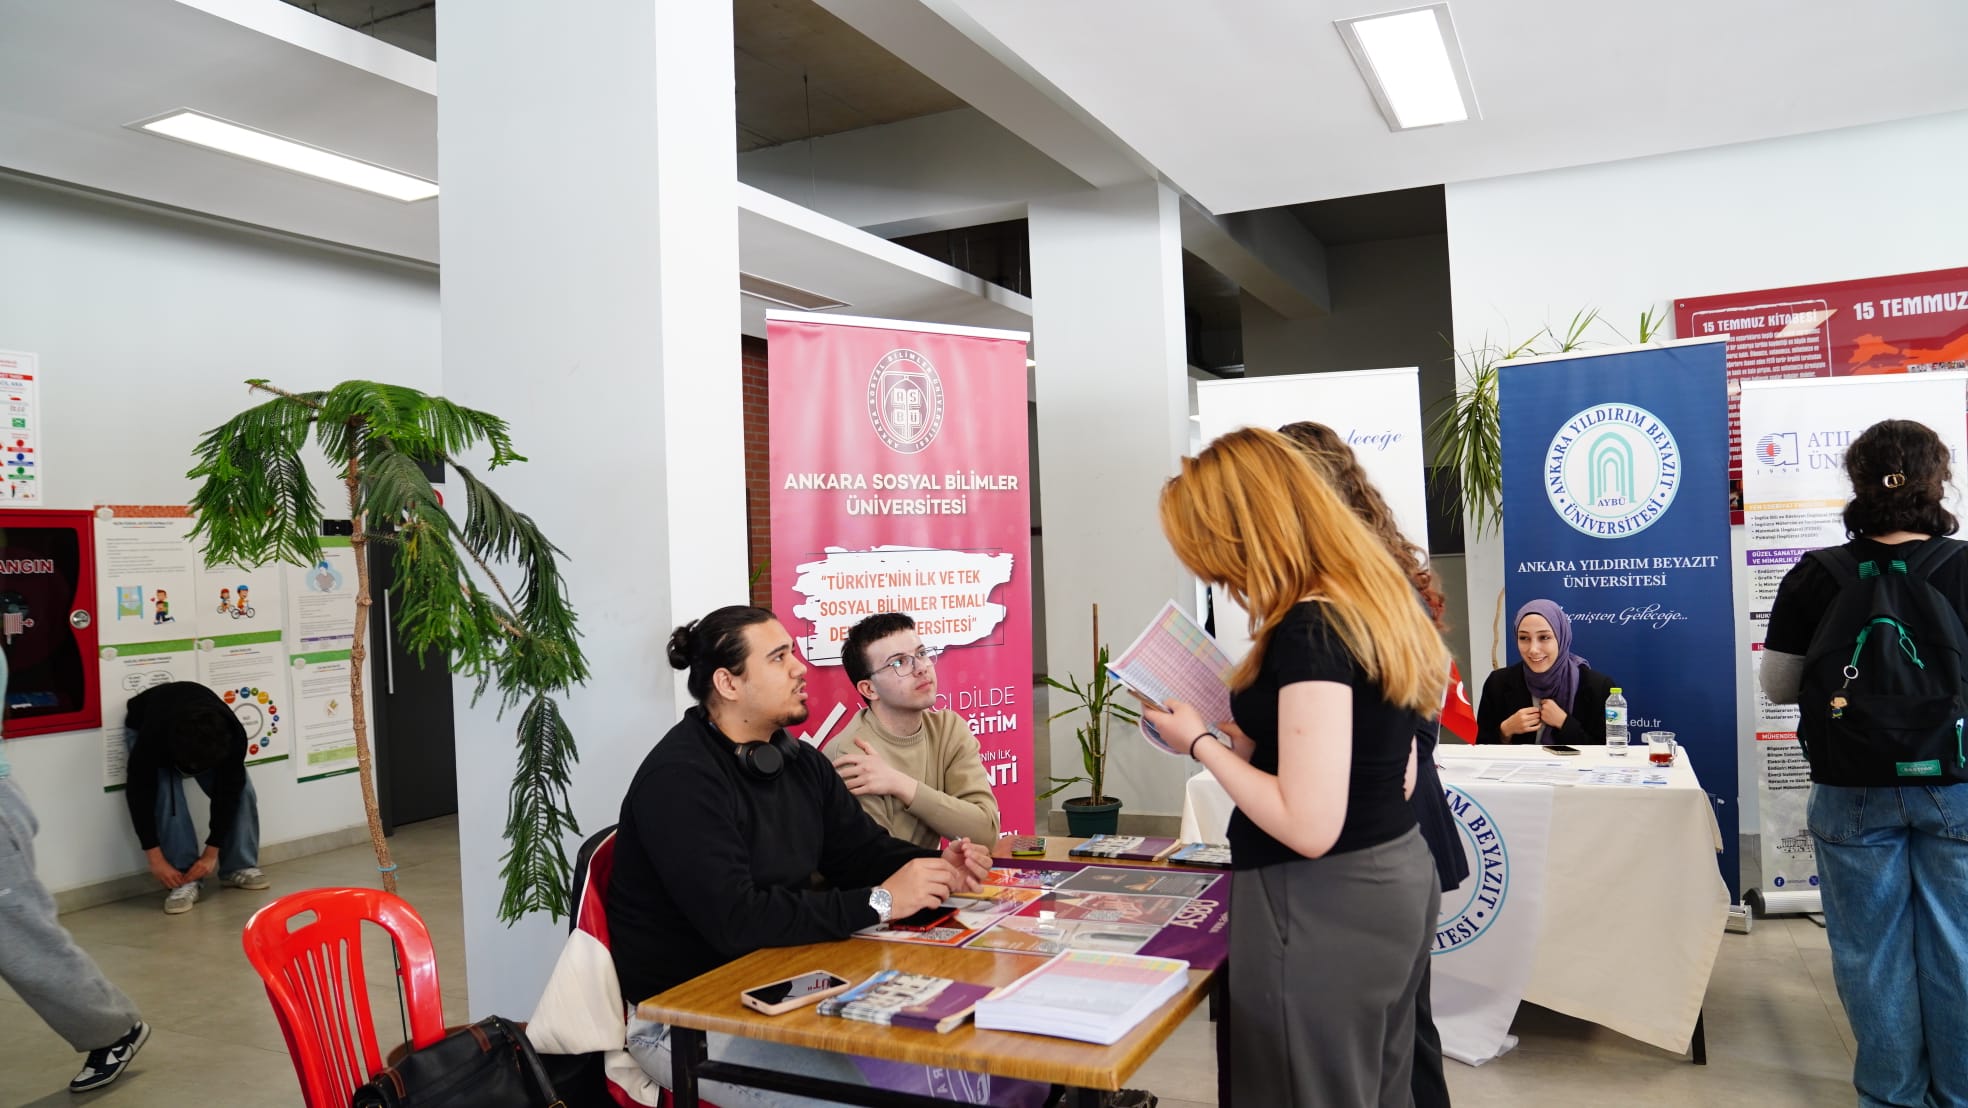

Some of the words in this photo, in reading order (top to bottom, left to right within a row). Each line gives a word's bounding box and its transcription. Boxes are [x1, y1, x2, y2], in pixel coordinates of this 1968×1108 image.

[1853, 301, 1875, 321] 15
[1880, 291, 1968, 318] TEMMUZ
[1703, 321, 1715, 333] 15
[1718, 316, 1765, 332] TEMMUZ
[1768, 308, 1817, 327] KİTABESİ
[1347, 429, 1402, 451] leceğe
[1549, 435, 1573, 495] ANKARA
[1570, 407, 1646, 436] YILDIRIM
[1646, 422, 1676, 490] BEYAZIT
[784, 473, 867, 490] ANKARA
[872, 474, 941, 490] SOSYAL
[945, 470, 1018, 490] BİLİMLER
[846, 494, 967, 515] ÜNİVERSİTESİ
[1597, 497, 1626, 507] AYBÜ
[1563, 498, 1663, 535] ÜNİVERSİTESİ
[0, 559, 54, 574] ANGIN
[1518, 560, 1576, 573] ANKARA
[1579, 558, 1649, 571] YILDIRIM
[1653, 556, 1719, 569] BEYAZIT
[915, 568, 936, 587] İLK
[940, 570, 955, 586] VE
[958, 569, 981, 585] TEK
[1563, 571, 1667, 588] ÜNİVERSİTESİ
[820, 599, 873, 617] SOSYAL
[877, 595, 937, 613] BİLİMLER
[941, 594, 986, 610] TEMALI
[1563, 607, 1618, 625] eçmişten
[914, 615, 977, 636] ERSİTESİ"
[960, 686, 1015, 710] DİLDE
[968, 711, 1017, 736] ĞİTİM
[1627, 717, 1661, 728] .edu.tr
[1468, 815, 1503, 910] BEYAZIT
